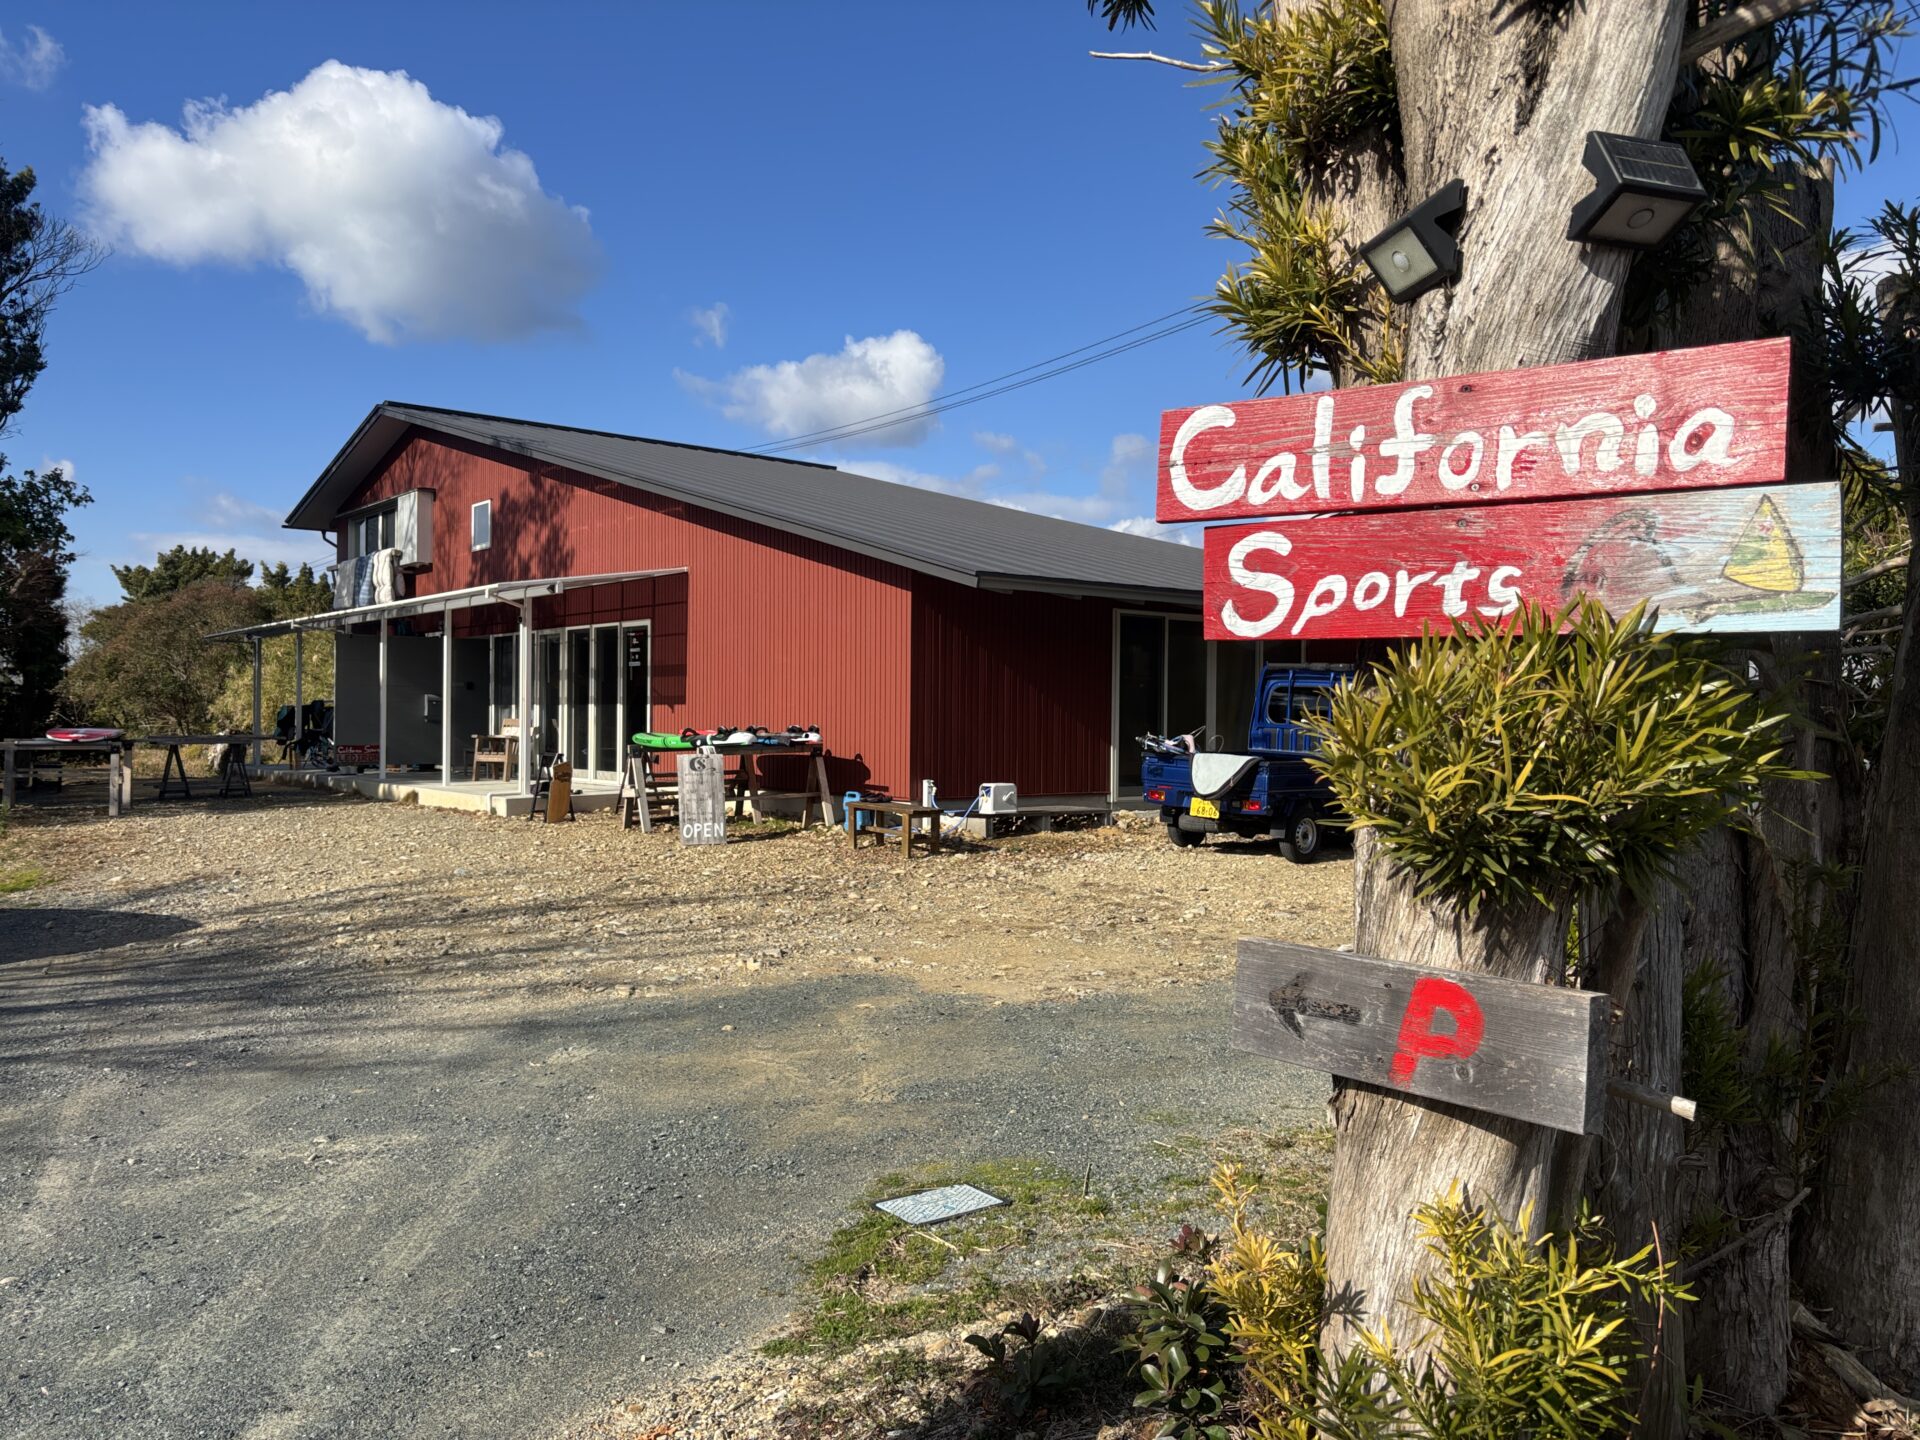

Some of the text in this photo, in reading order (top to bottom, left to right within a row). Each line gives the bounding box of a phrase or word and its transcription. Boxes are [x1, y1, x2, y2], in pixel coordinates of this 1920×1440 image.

[1168, 384, 1742, 512] California
[1220, 531, 1522, 640] Sports
[682, 822, 725, 839] OPEN
[1387, 976, 1485, 1089] P
